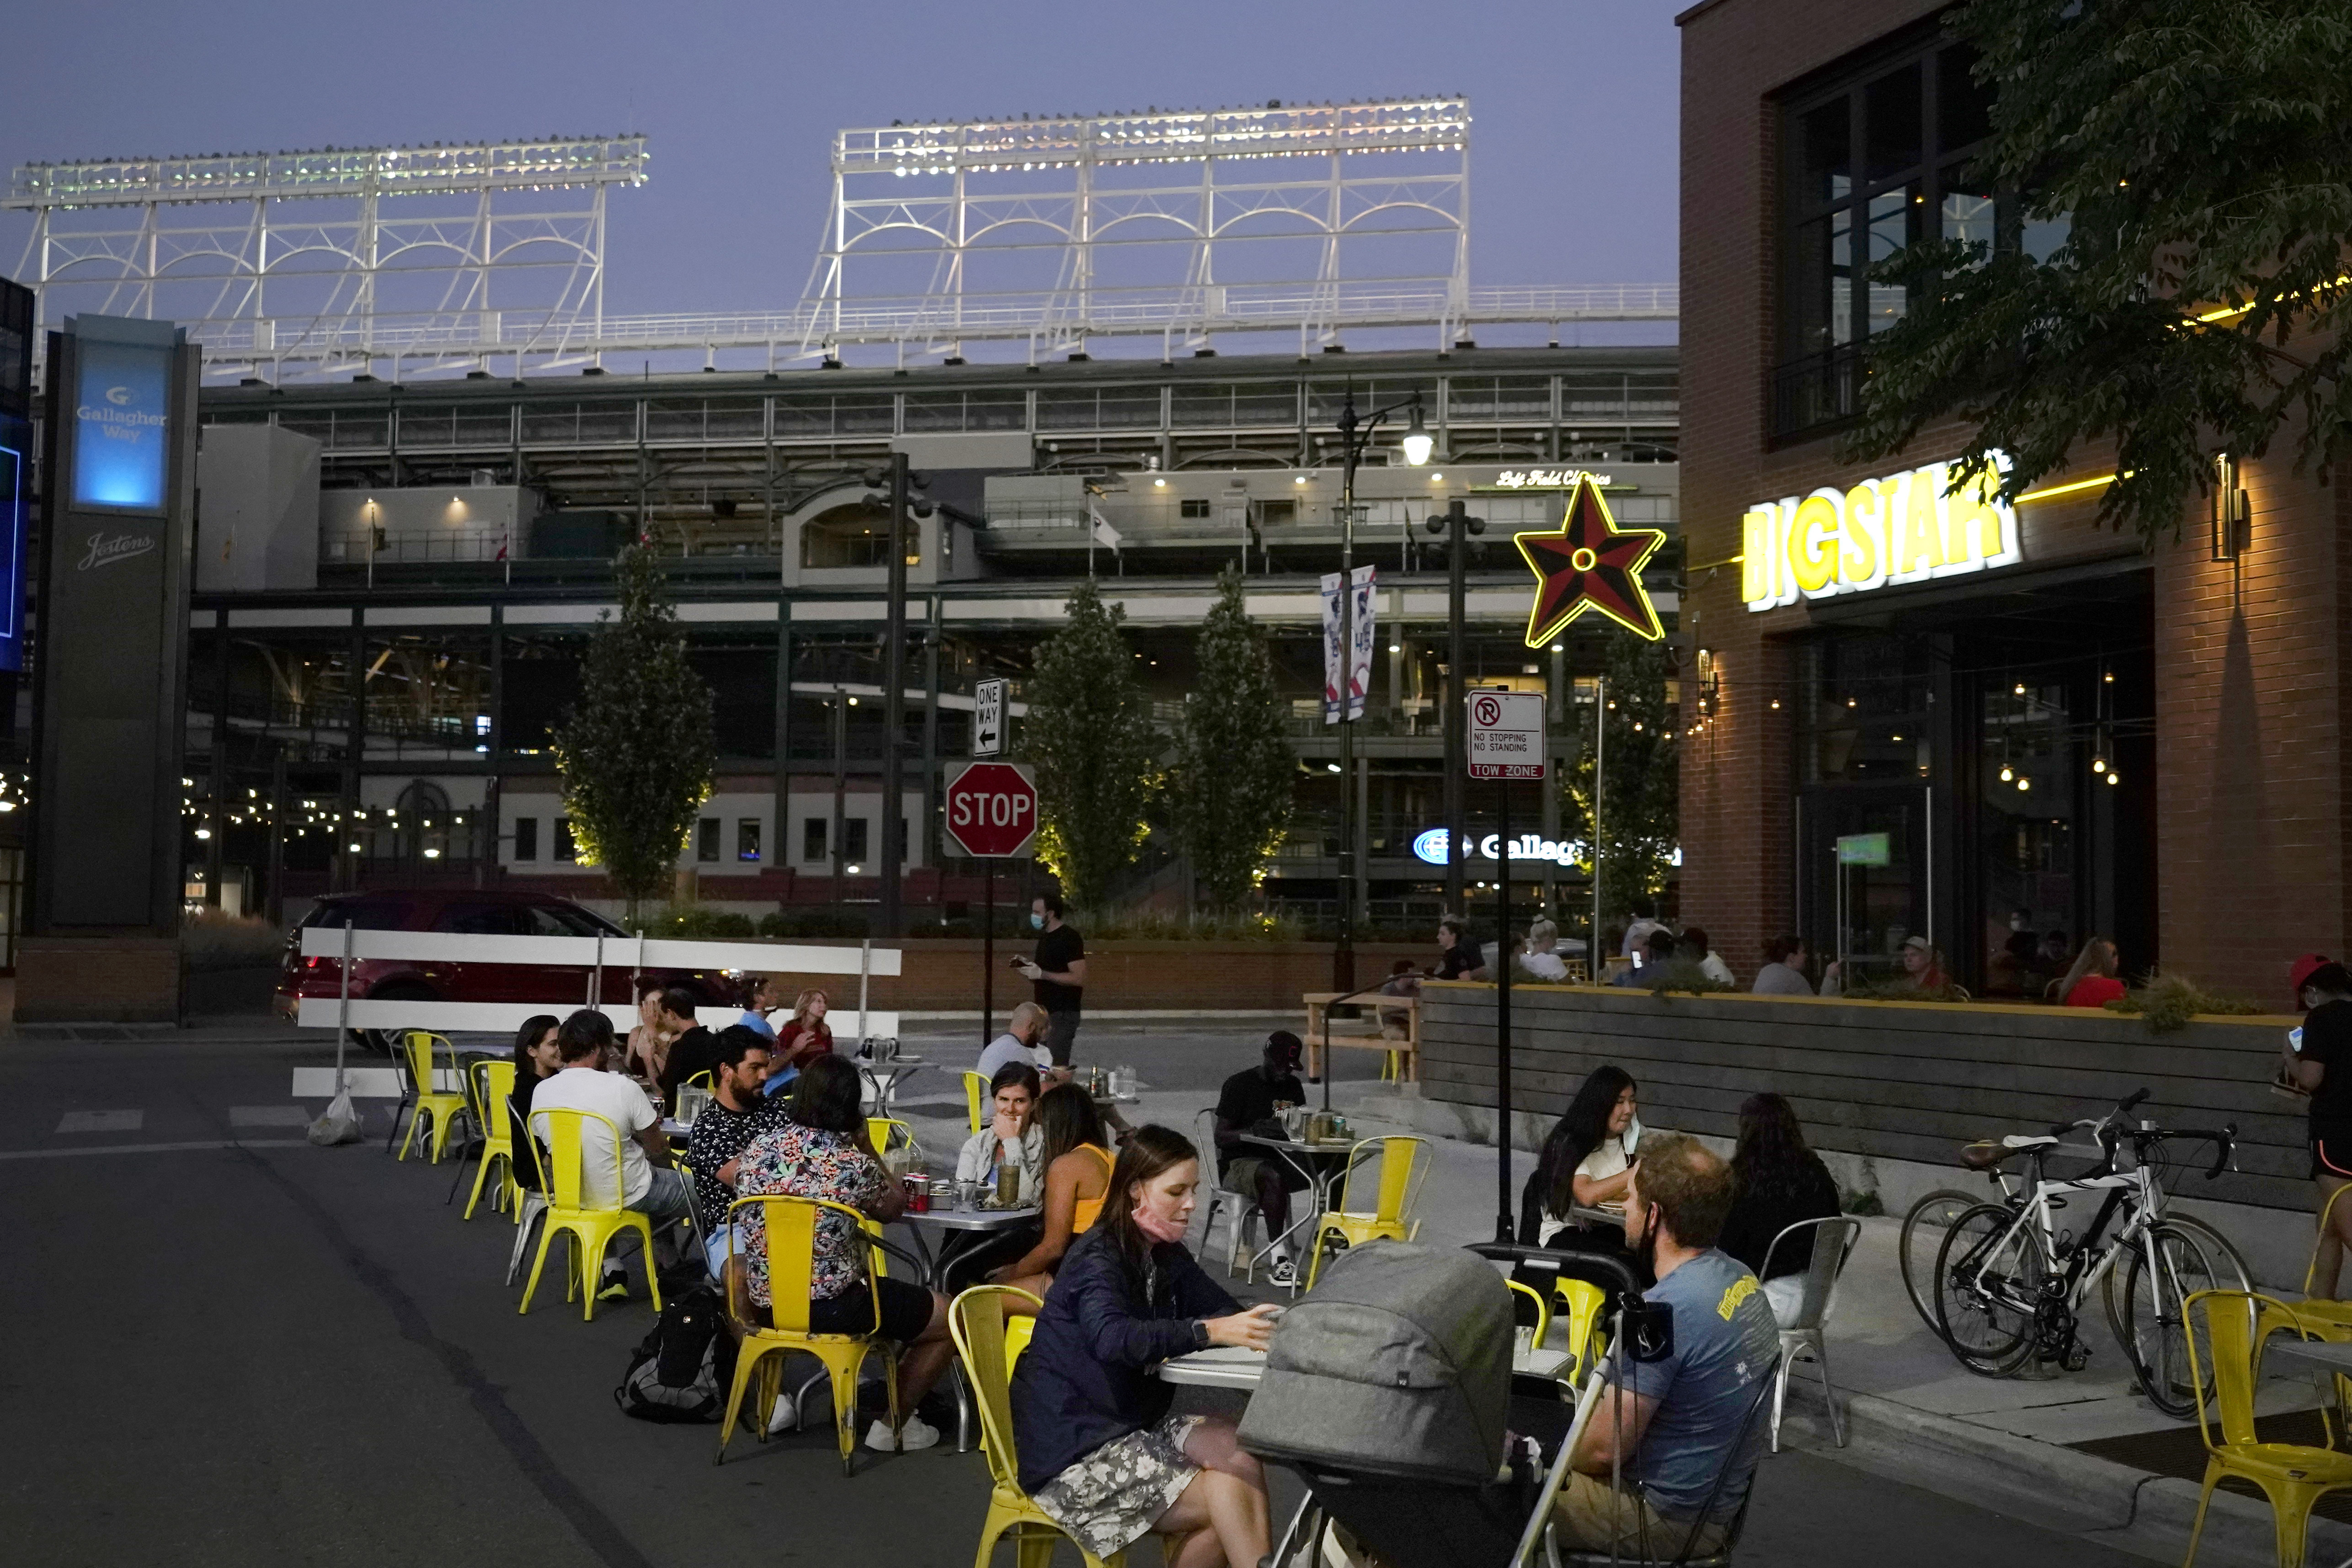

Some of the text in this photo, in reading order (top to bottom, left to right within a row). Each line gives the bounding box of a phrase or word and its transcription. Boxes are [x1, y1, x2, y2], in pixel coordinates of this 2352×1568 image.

[77, 405, 167, 427] Gallagher
[102, 424, 140, 443] Way
[1496, 470, 1611, 488] Left Field Clics
[77, 532, 154, 571] Jostens
[979, 686, 997, 704] ONE
[978, 707, 997, 725] WAY
[1474, 733, 1527, 742] NO STOPPING
[1474, 743, 1527, 752] NO STANDING
[1475, 765, 1538, 777] TOW ZONE
[954, 792, 1030, 827] STOP
[1480, 834, 1611, 866] Gallag
